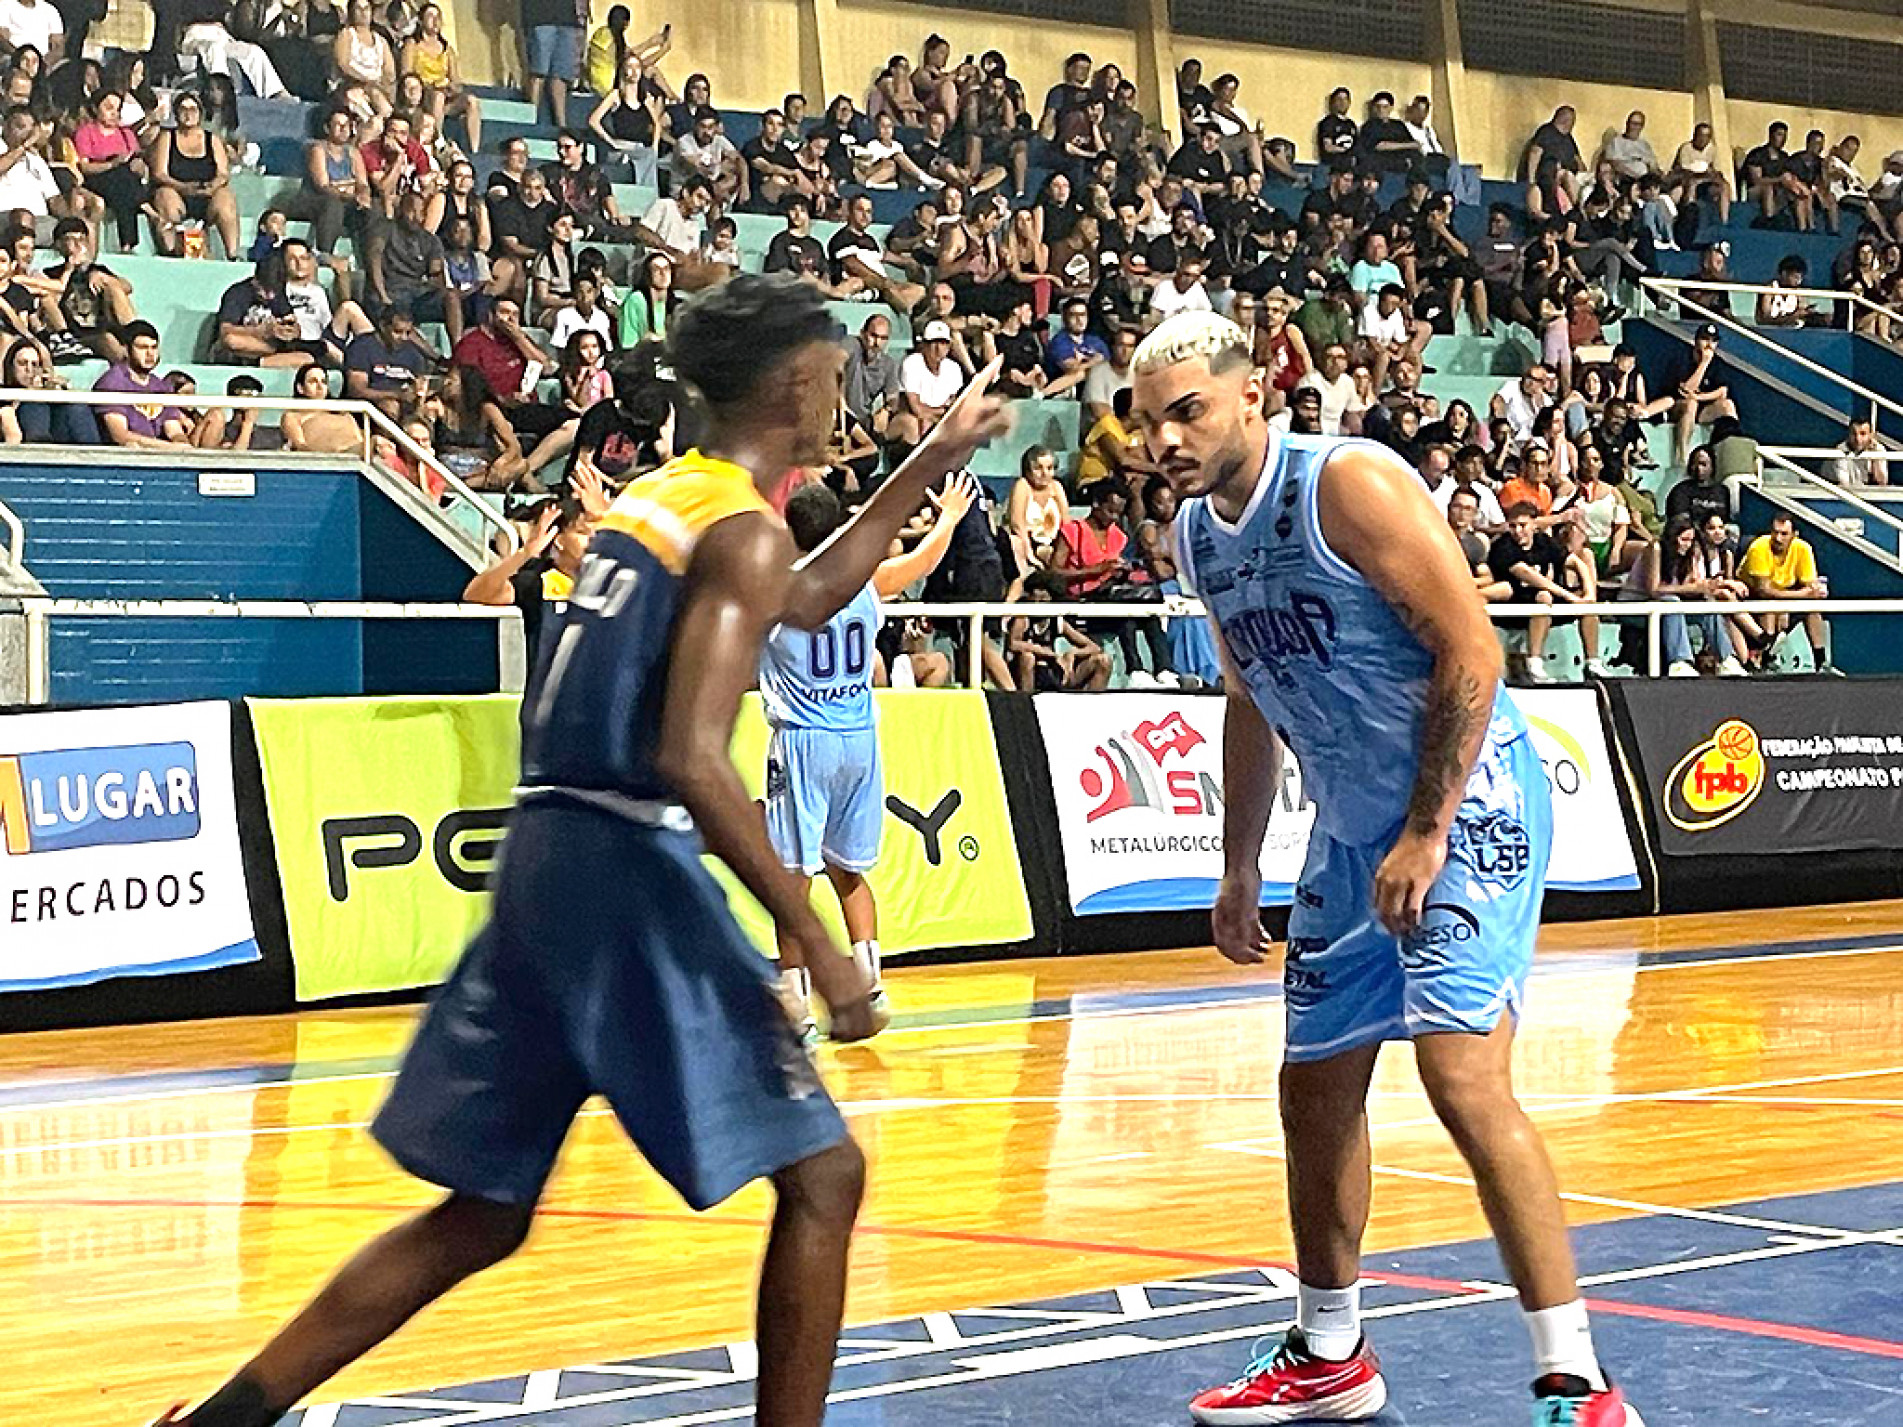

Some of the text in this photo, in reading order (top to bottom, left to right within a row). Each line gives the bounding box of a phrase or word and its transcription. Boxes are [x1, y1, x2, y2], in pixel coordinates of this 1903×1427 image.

[809, 620, 866, 679] 00
[30, 767, 195, 827] LUGAR
[1694, 761, 1748, 801] fpb
[1776, 767, 1889, 790] CAMPEONATO
[1091, 833, 1225, 854] METALÚRGICO
[10, 870, 206, 923] ERCADOS
